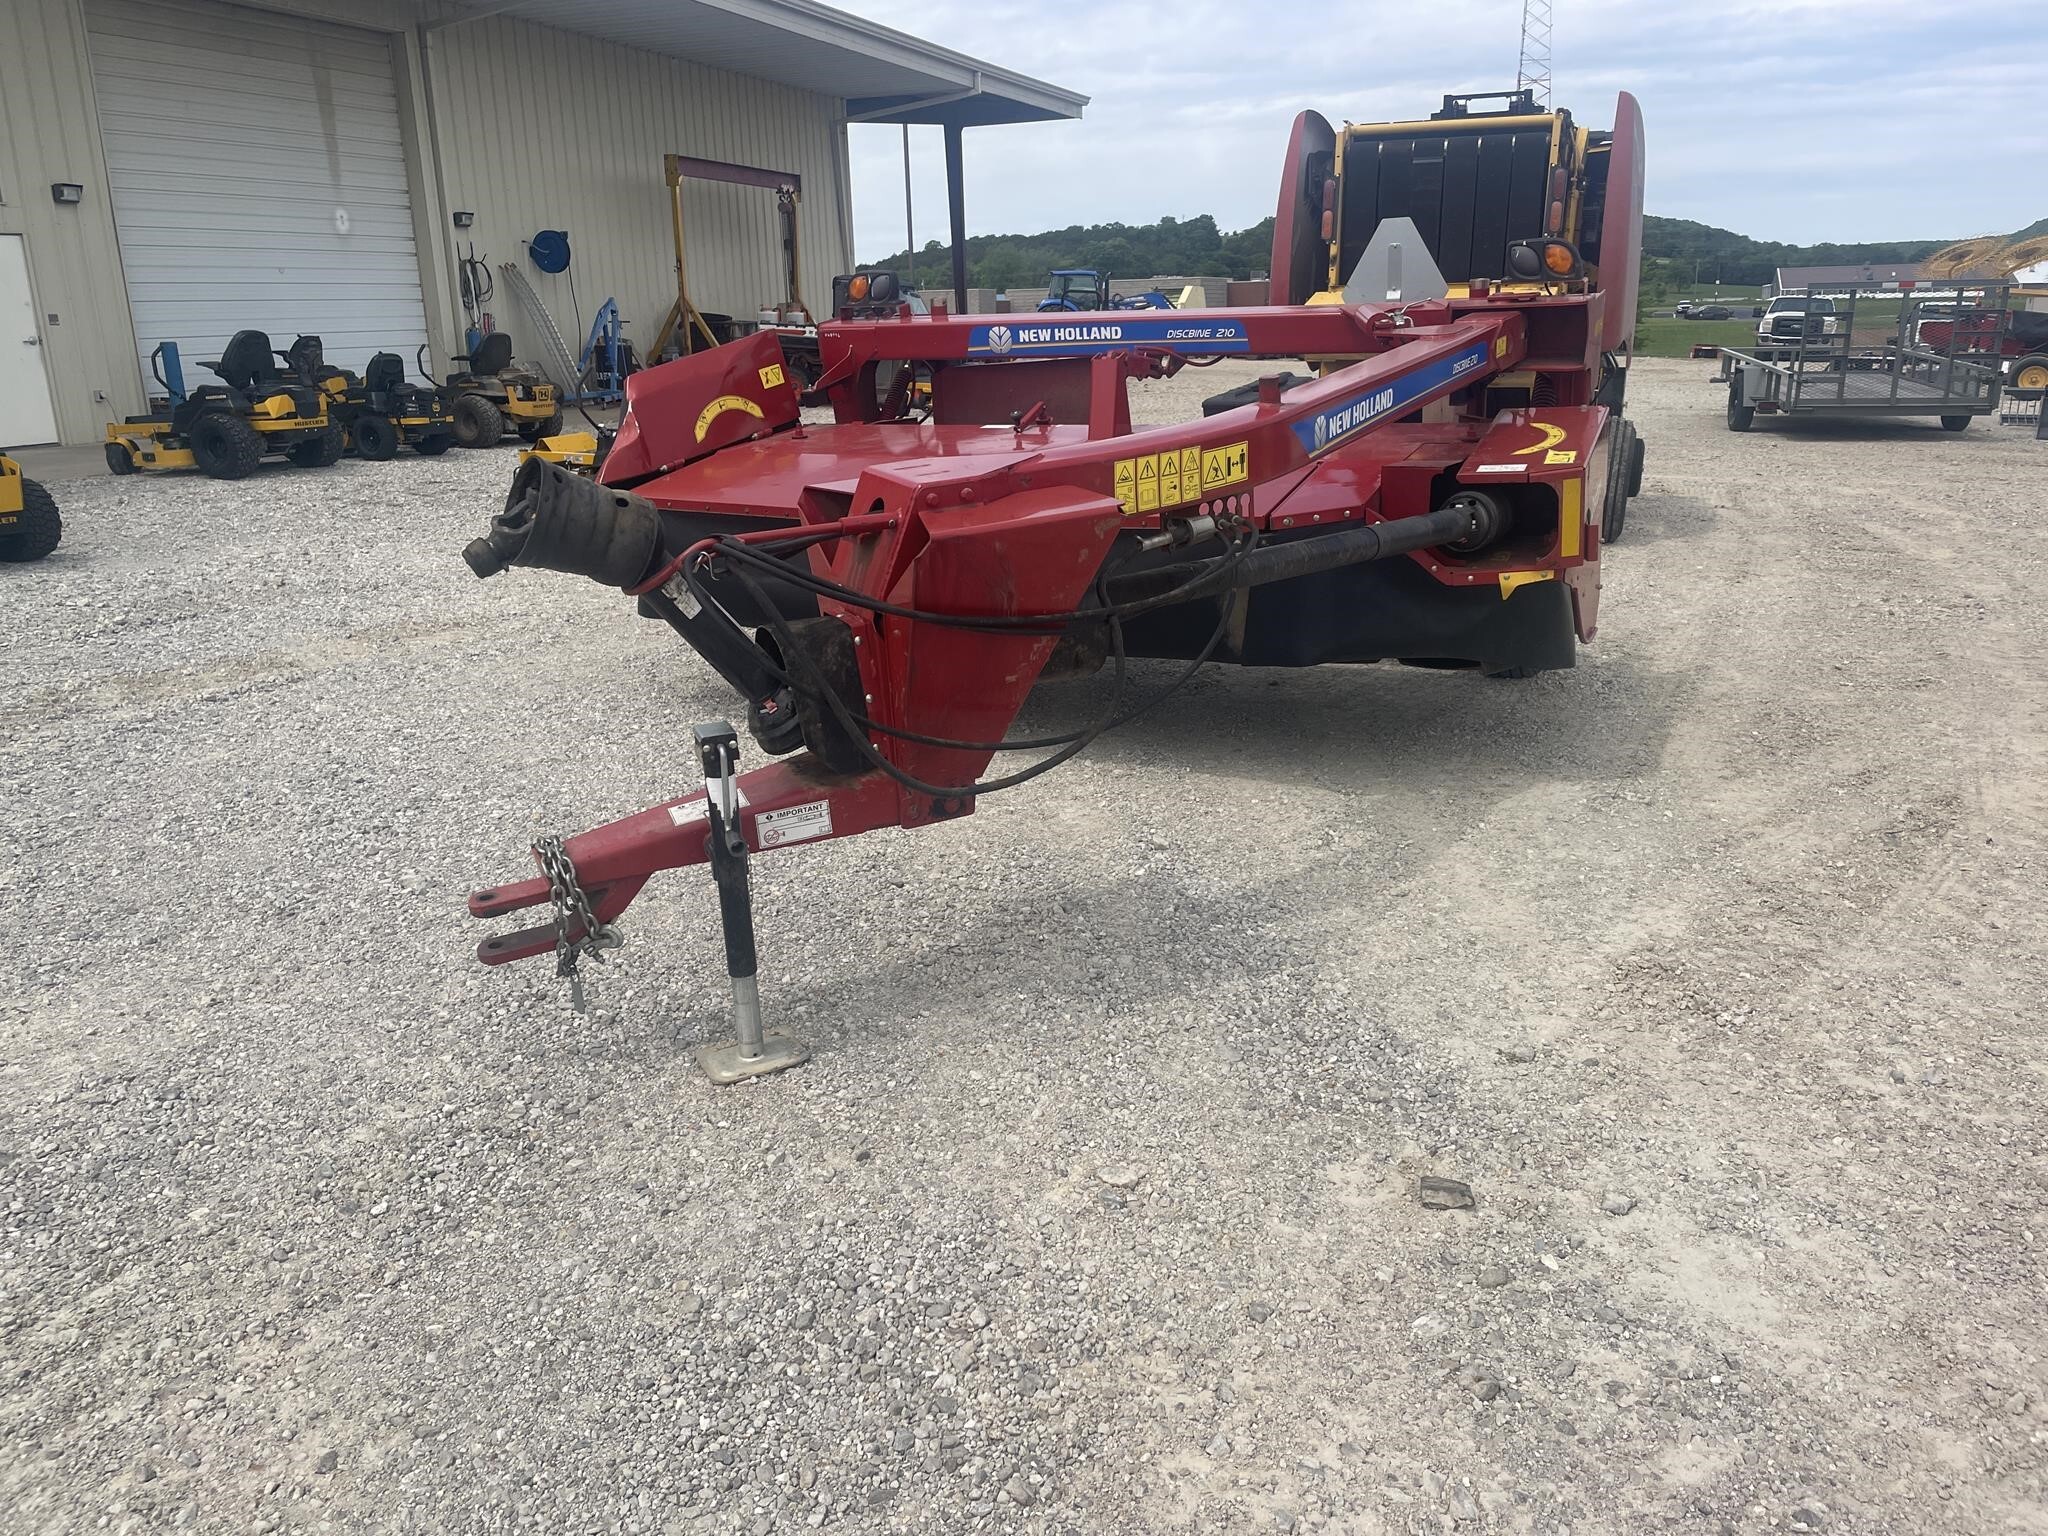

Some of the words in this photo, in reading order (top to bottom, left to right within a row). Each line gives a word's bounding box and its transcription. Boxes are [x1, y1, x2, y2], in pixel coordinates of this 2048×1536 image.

[1019, 328, 1051, 343] NEW
[1054, 326, 1122, 342] HOLLAND
[1166, 329, 1211, 339] DISCBINE
[1216, 328, 1235, 338] 210
[1329, 409, 1351, 439] NEW
[1353, 388, 1394, 426] HOLLAND
[776, 803, 824, 819] IMPORTANT
